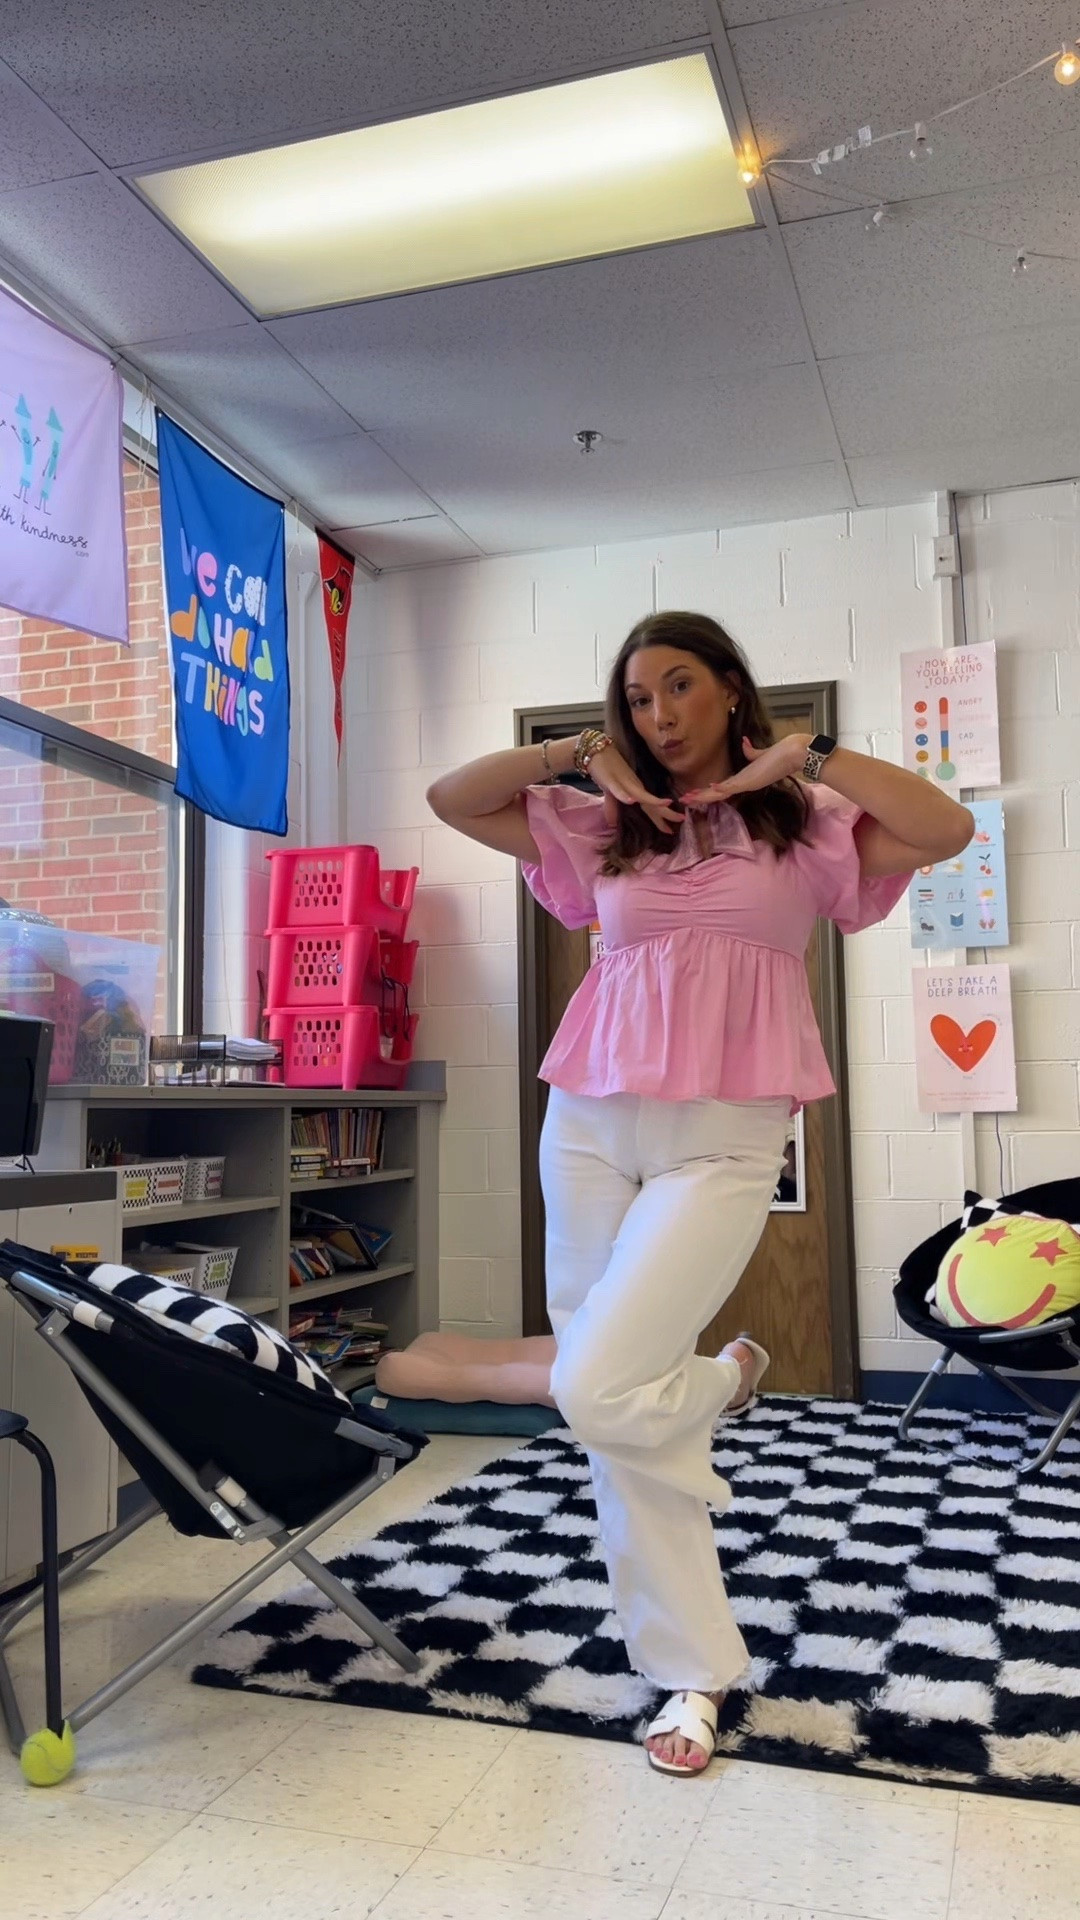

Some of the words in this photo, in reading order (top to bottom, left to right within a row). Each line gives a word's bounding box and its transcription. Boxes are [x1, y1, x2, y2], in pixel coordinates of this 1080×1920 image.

[20, 515, 89, 549] kindness
[924, 658, 947, 669] HOW
[954, 654, 972, 665] ARE
[916, 669, 939, 678] YOU
[943, 662, 983, 676] FEELING
[928, 674, 971, 686] TODAY?
[926, 977, 953, 988] LET'S
[959, 976, 983, 986] TAKE
[990, 975, 998, 985] A
[927, 987, 953, 998] DEEP
[957, 985, 998, 997] BREATH
